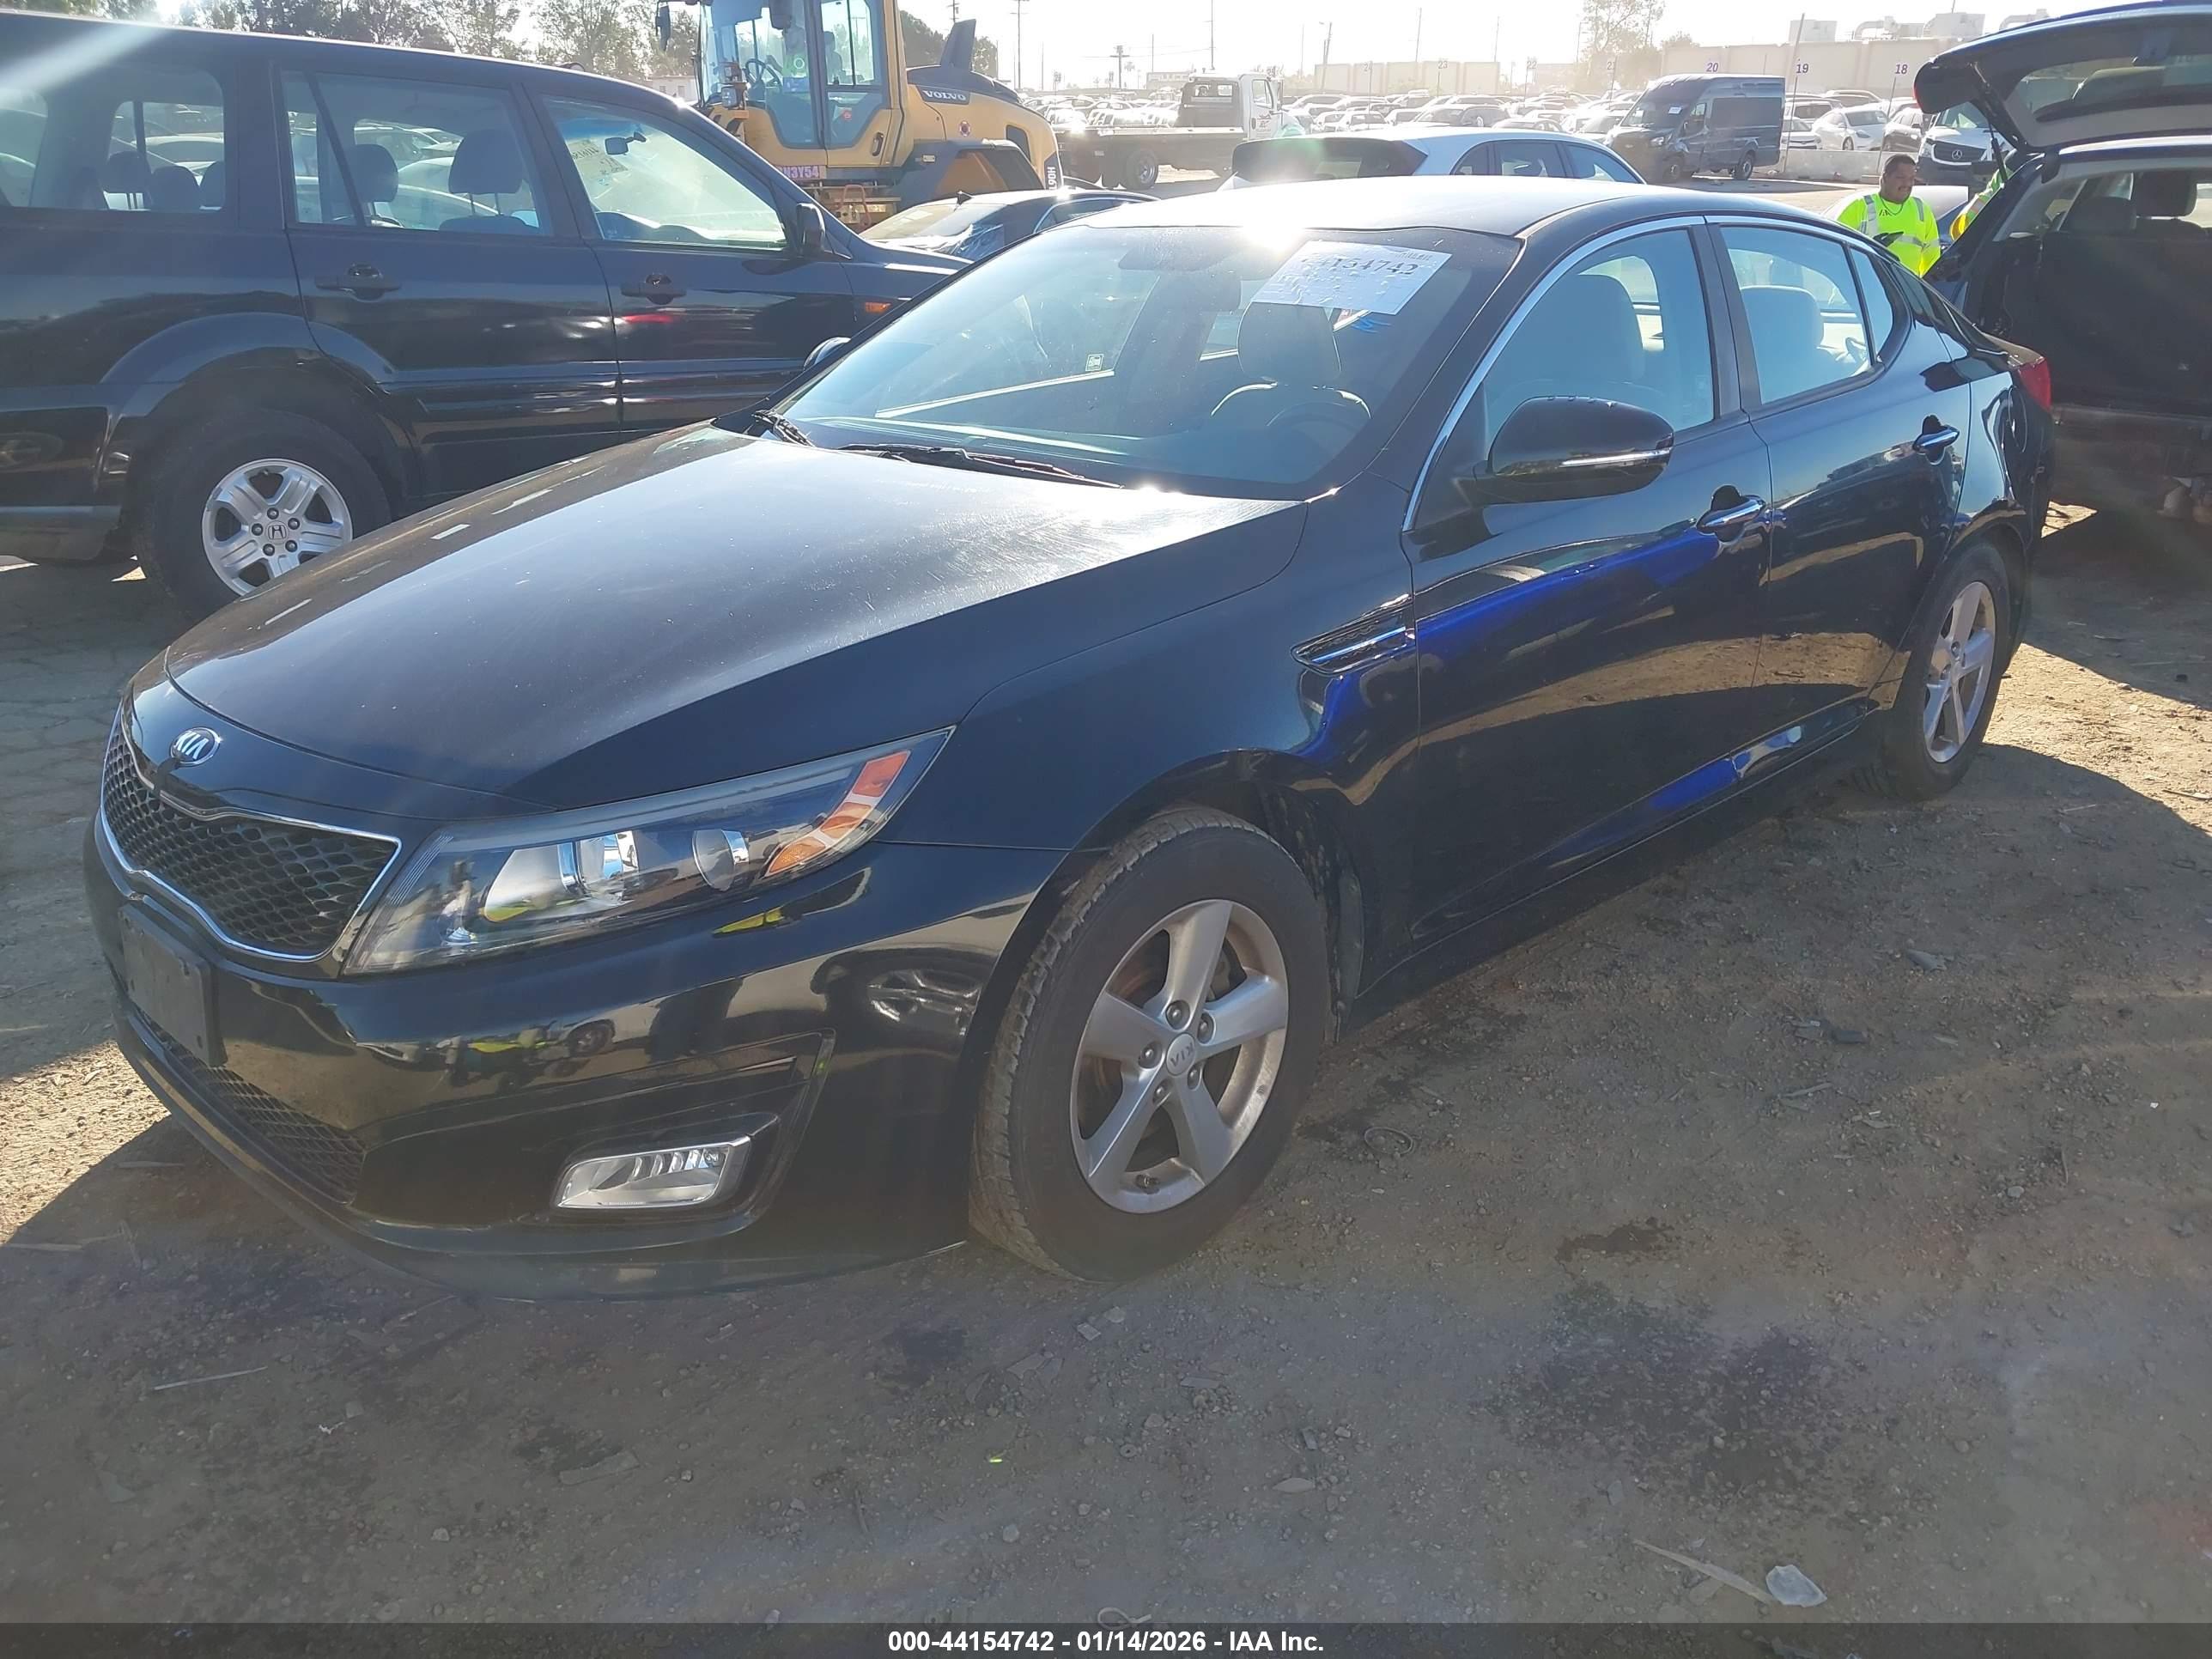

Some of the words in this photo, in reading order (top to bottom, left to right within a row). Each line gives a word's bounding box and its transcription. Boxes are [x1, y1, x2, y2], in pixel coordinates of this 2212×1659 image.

[1437, 60, 1448, 70] 23
[1705, 63, 1718, 72] 20
[1796, 64, 1809, 73] 19
[1894, 64, 1908, 74] 18
[922, 90, 966, 100] VOLVO
[173, 732, 210, 760] KIA
[1170, 1042, 1194, 1066] KIA
